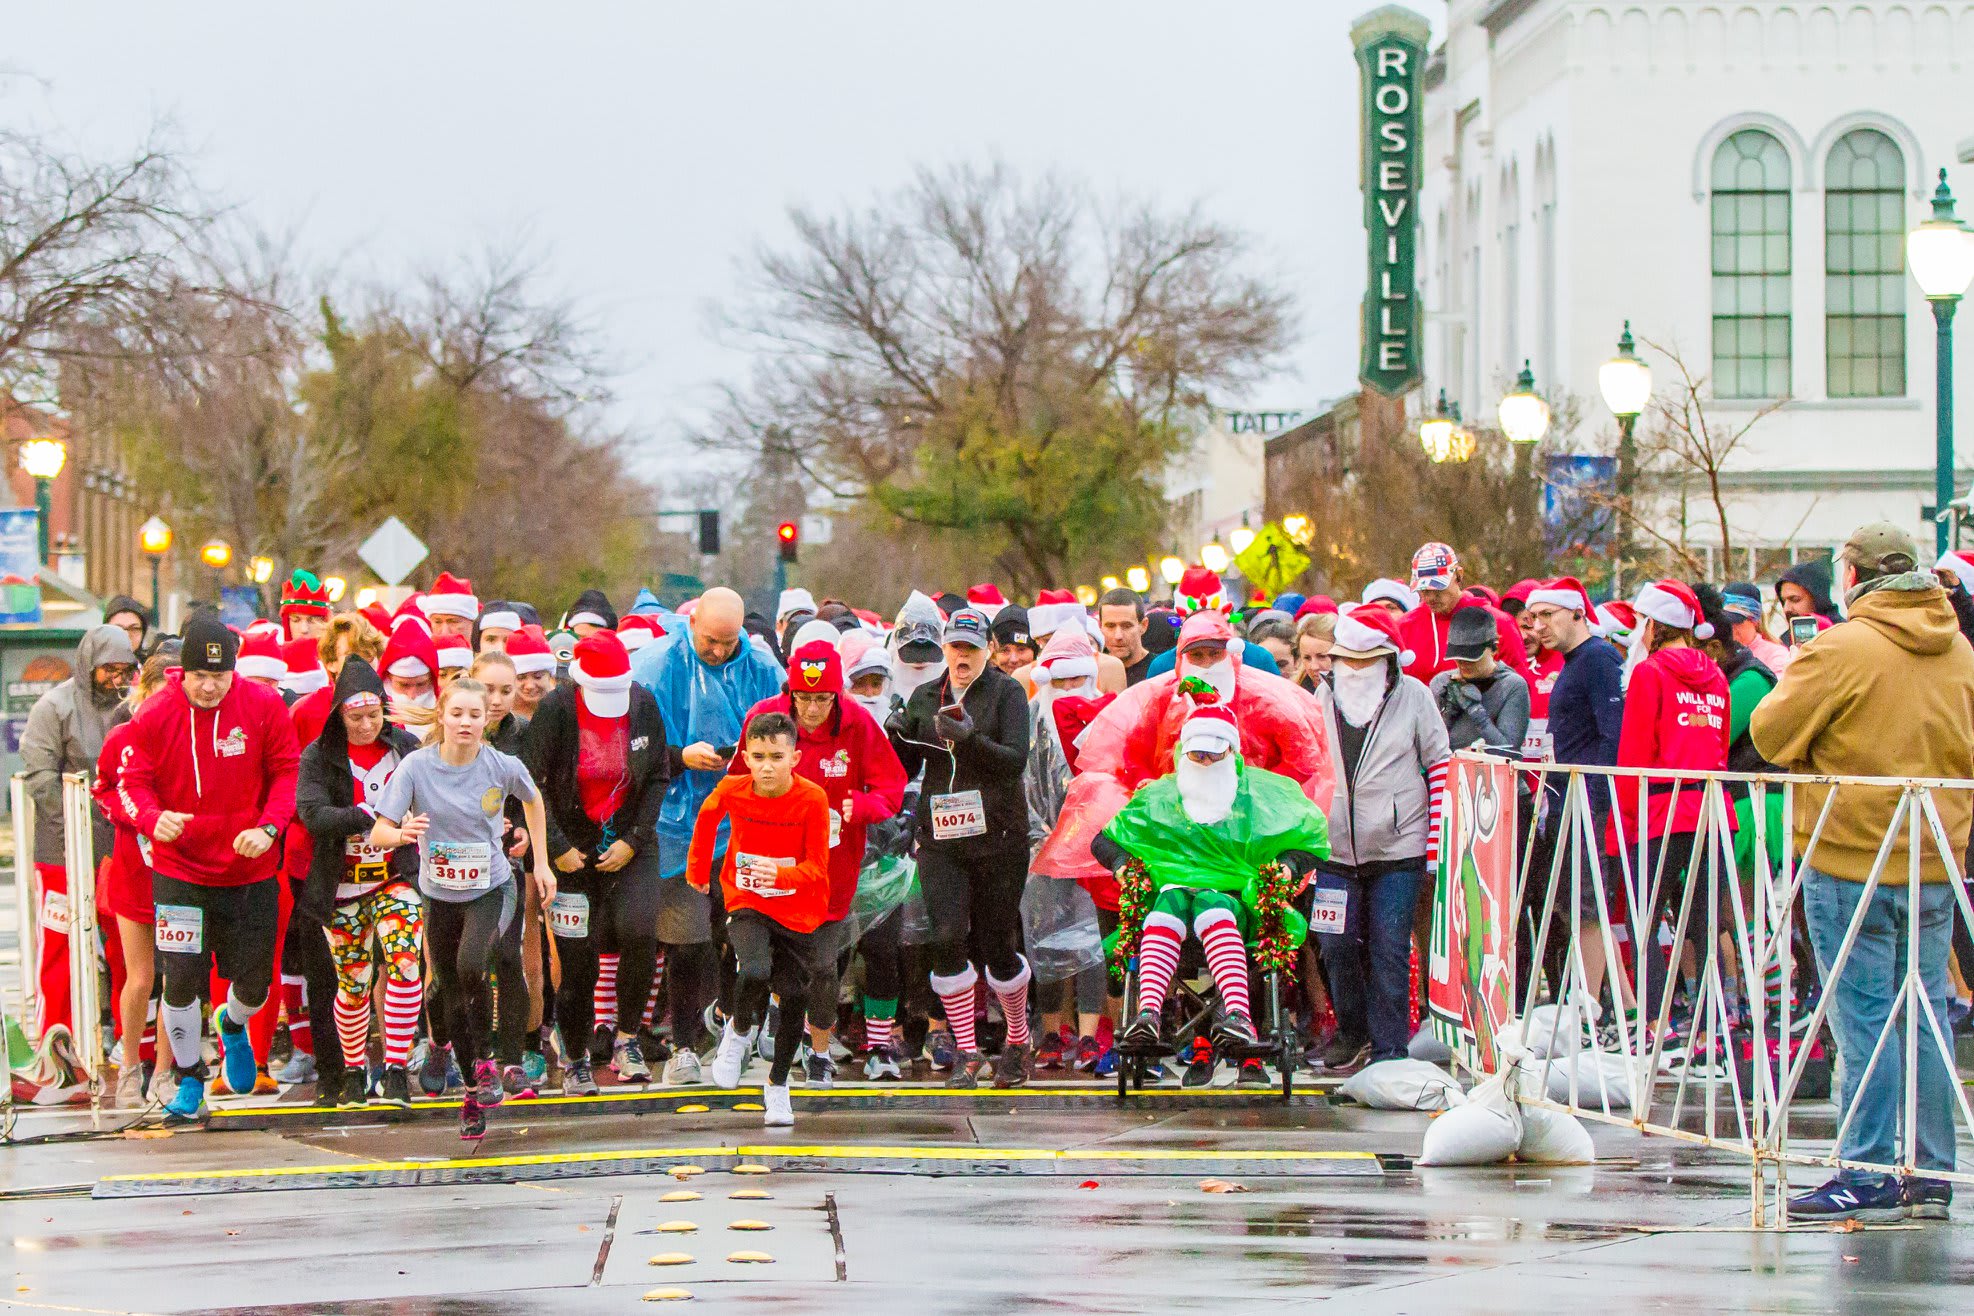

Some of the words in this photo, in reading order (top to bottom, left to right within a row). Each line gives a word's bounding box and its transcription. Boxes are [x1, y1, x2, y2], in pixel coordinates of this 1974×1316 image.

[1374, 47, 1410, 372] ROSEVILLE
[1014, 633, 1028, 643] CAT
[1676, 691, 1705, 704] WILL
[1705, 693, 1726, 709] RUN
[1696, 705, 1712, 714] FOR
[935, 813, 976, 828] 16074
[436, 866, 479, 880] 3810
[742, 876, 761, 888] 38
[47, 909, 66, 922] 166
[550, 911, 580, 926] 6119
[159, 929, 194, 942] 3607
